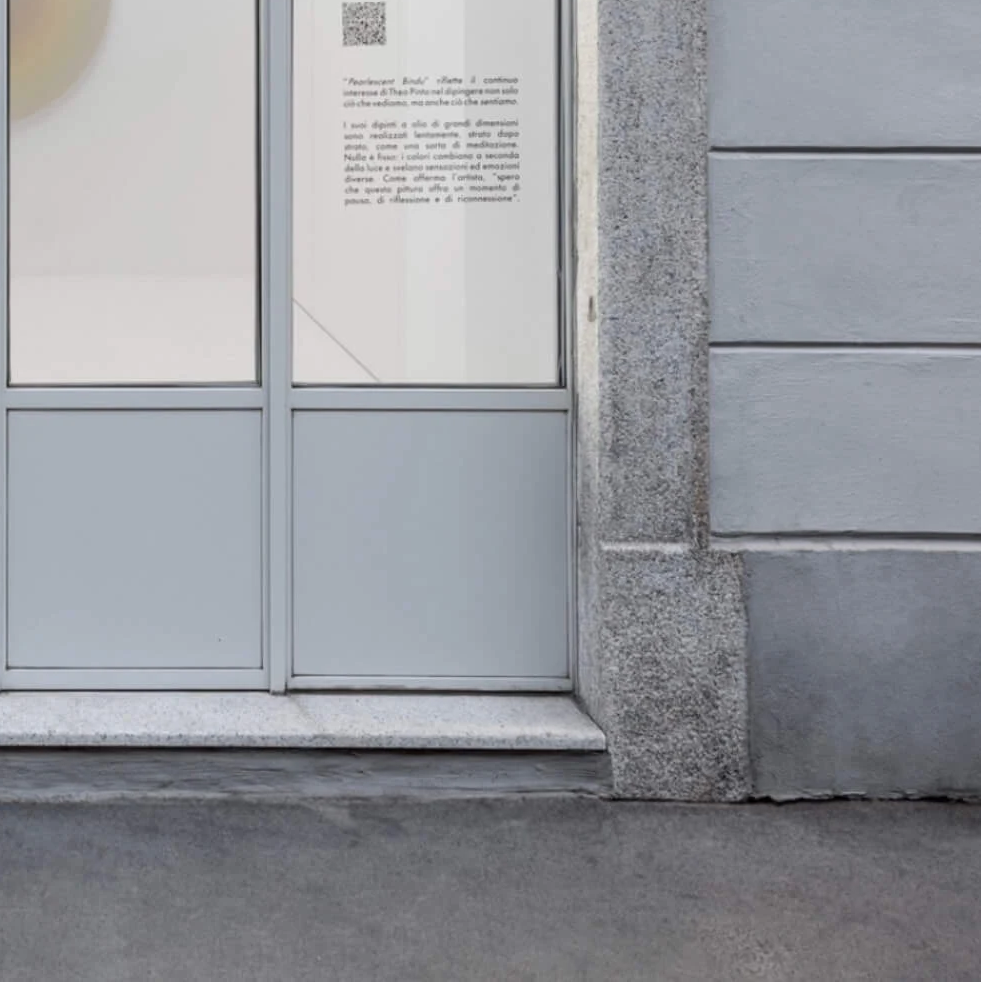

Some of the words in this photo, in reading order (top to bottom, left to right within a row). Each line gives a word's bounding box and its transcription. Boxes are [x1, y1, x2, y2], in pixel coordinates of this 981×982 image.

[389, 88, 408, 96] Theo
[410, 88, 429, 96] Pinto
[431, 88, 443, 96] nel
[445, 88, 483, 98] dipingere
[502, 87, 518, 95] solo
[357, 99, 371, 107] che
[451, 98, 463, 106] ciò
[464, 98, 478, 106] che
[372, 121, 396, 130] dipinti
[444, 120, 470, 130] grandi
[497, 130, 519, 140] dopo
[466, 141, 518, 149] meditazione.
[433, 152, 472, 160] cambiano
[344, 164, 365, 172] della
[366, 164, 383, 172] luce
[393, 163, 423, 171] svelano
[470, 163, 481, 171] ed
[382, 174, 406, 182] Come
[414, 174, 446, 182] afferma
[344, 186, 359, 194] che
[397, 185, 423, 194] pittura
[389, 196, 430, 204] riflessione
